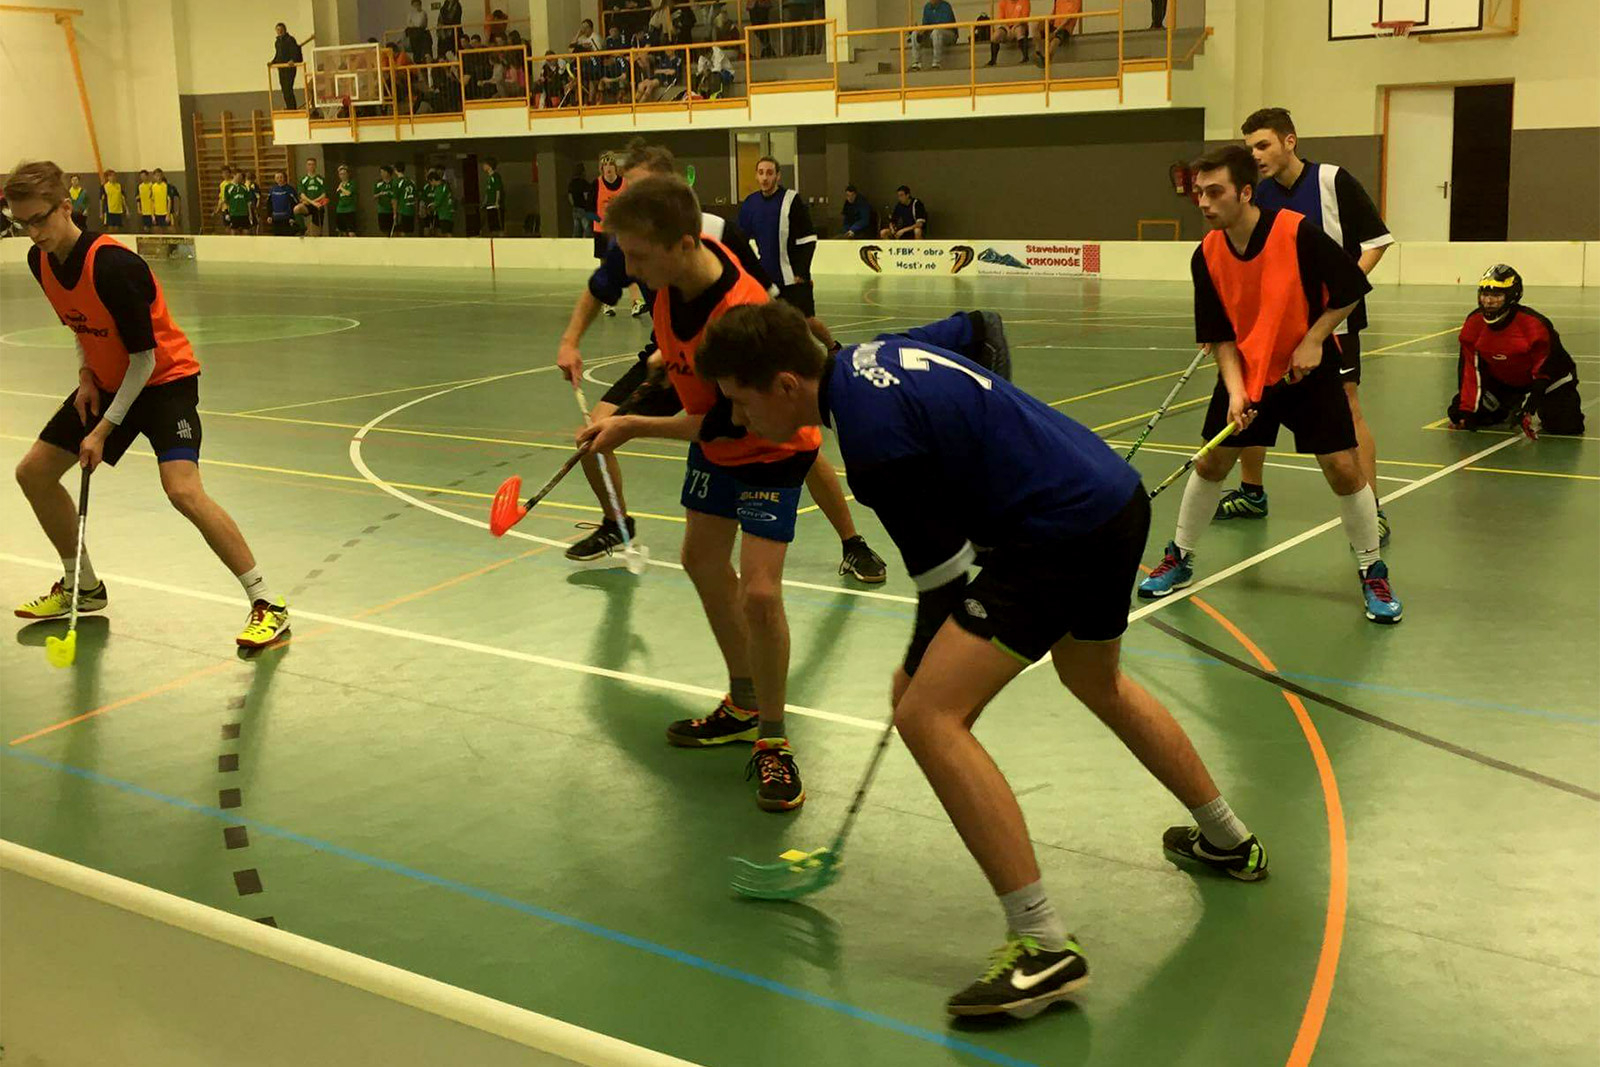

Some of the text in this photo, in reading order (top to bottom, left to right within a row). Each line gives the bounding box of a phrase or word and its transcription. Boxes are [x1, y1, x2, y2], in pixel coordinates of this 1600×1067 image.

[917, 247, 944, 256] obra
[1026, 244, 1081, 255] Stavebniny
[1026, 257, 1081, 267] KRKONOŠE
[689, 469, 711, 499] 73
